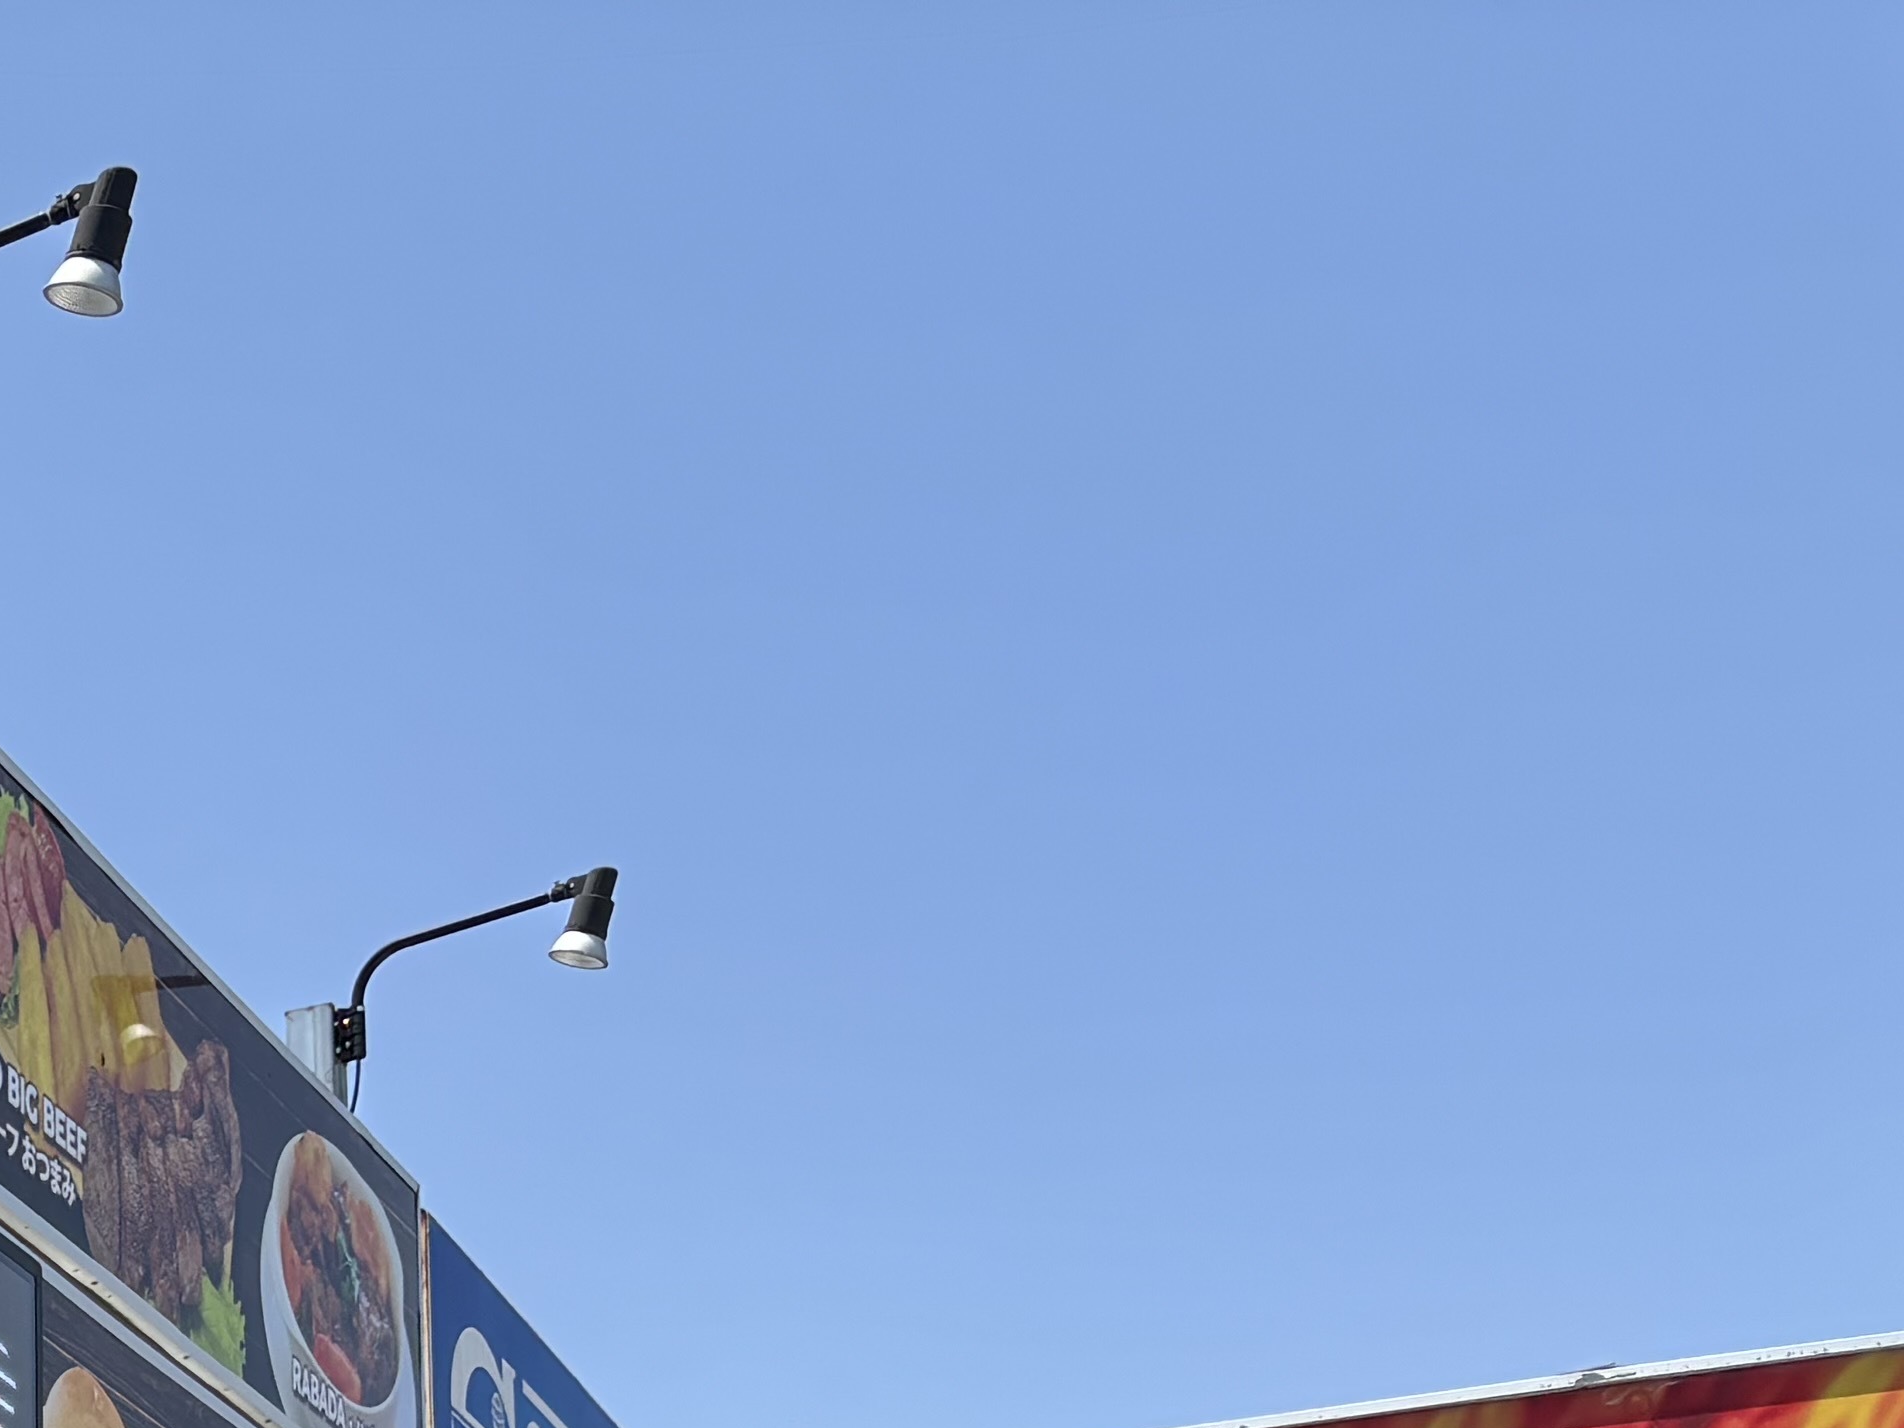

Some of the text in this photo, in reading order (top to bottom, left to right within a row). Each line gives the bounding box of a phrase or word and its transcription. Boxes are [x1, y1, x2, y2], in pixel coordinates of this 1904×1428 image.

[7, 1063, 39, 1126] BIG
[43, 1096, 89, 1164] BEEF
[21, 1135, 77, 1207] おつまみ
